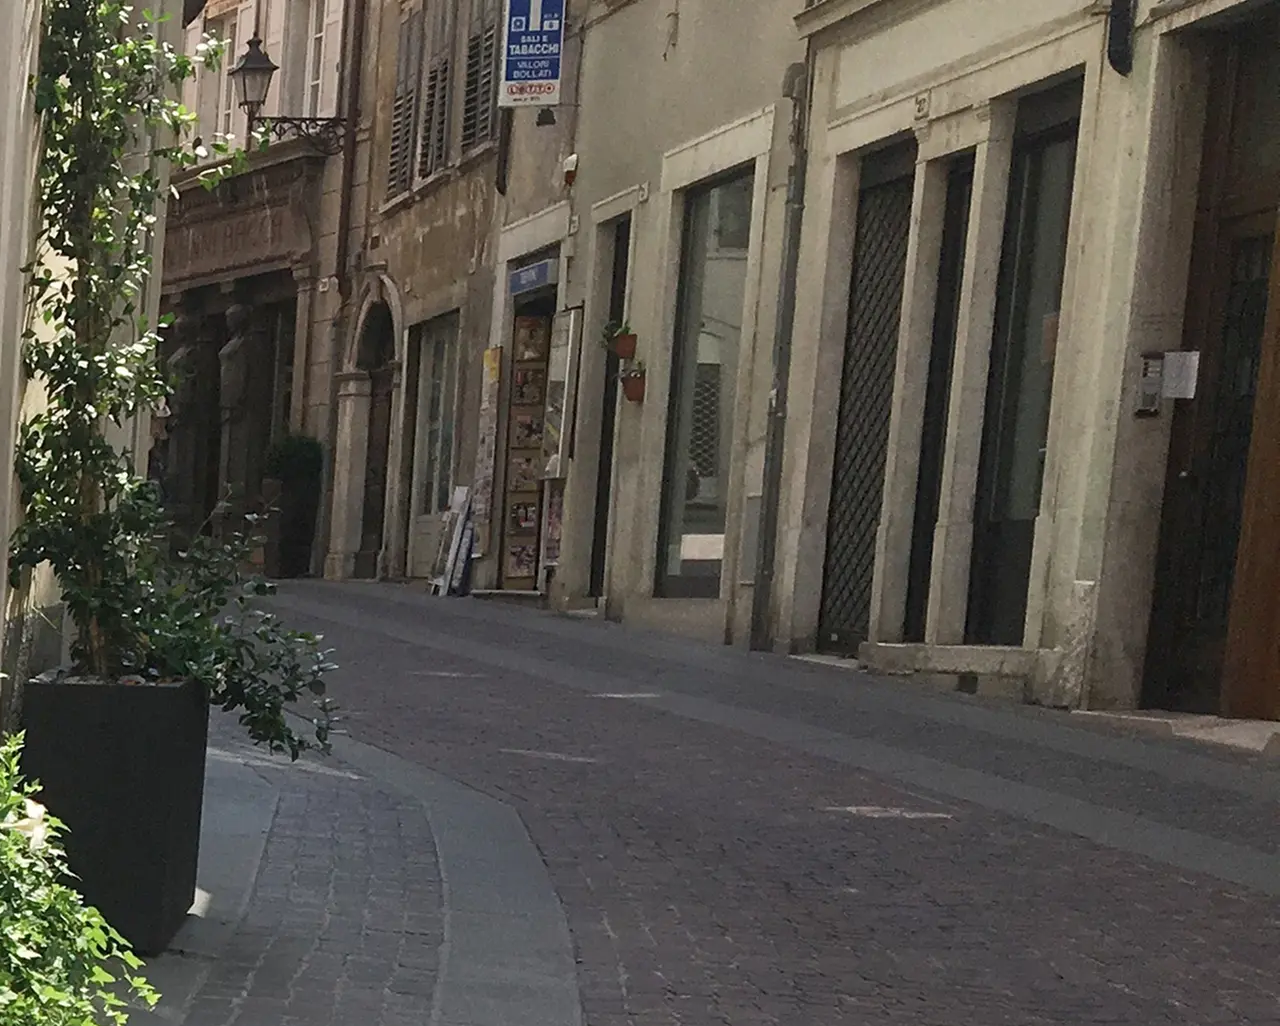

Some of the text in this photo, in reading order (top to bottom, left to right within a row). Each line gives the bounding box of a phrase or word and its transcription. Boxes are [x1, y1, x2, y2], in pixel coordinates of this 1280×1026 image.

[509, 43, 559, 55] TABACCHI
[517, 61, 550, 69] VALORI
[513, 70, 552, 79] BOLLATI
